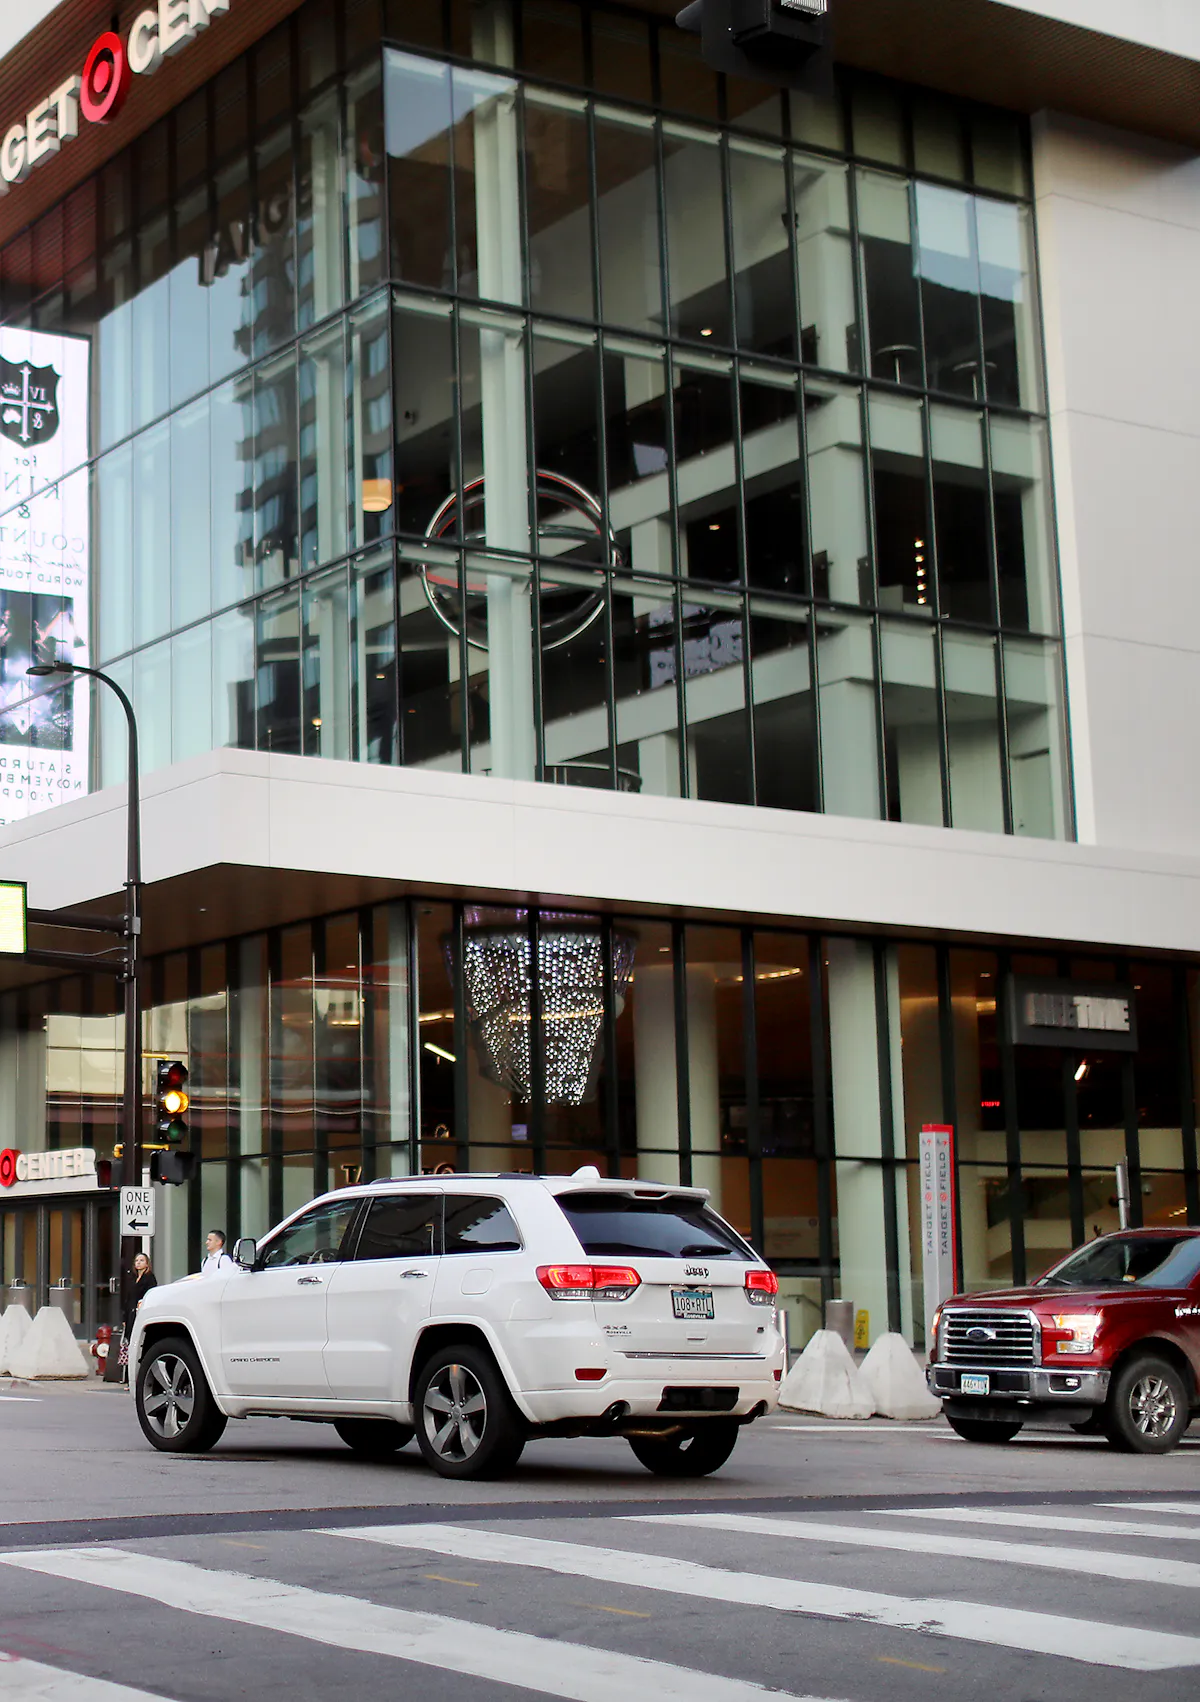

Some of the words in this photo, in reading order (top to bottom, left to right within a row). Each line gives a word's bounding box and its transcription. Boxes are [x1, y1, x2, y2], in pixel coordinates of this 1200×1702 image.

[16, 1148, 90, 1181] CENTER
[924, 1151, 932, 1190] FIELD
[939, 1151, 947, 1190] FIELD
[125, 1204, 151, 1216] WAY
[126, 1191, 150, 1203] ONE
[925, 1204, 933, 1256] TARGET
[941, 1204, 949, 1256] TARGET
[684, 1264, 710, 1279] Jeep
